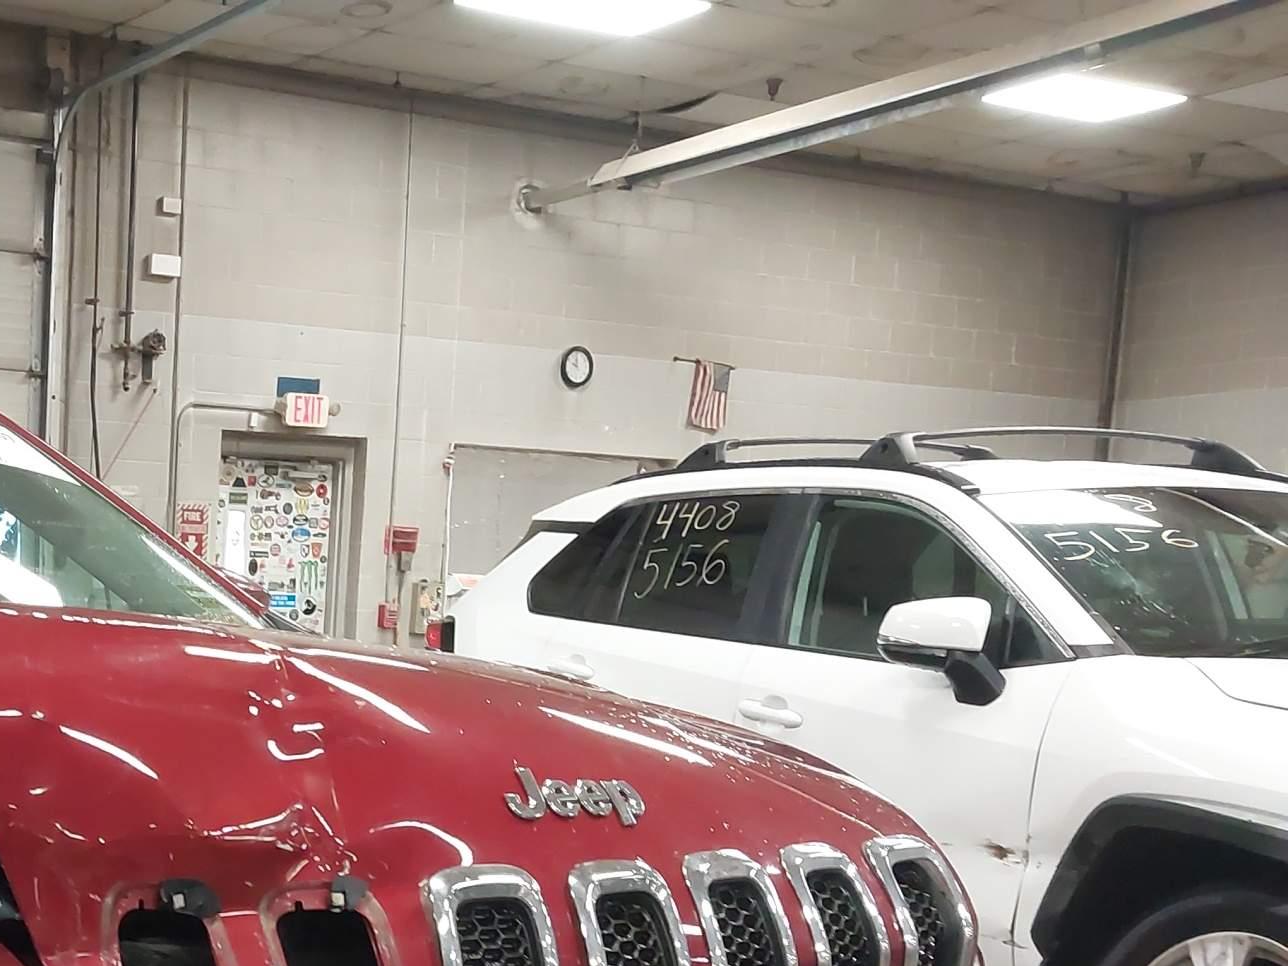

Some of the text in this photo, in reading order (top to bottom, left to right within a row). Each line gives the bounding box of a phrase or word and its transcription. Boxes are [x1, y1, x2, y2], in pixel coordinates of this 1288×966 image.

[294, 395, 324, 424] EXIT
[653, 500, 740, 543] 4408
[1044, 527, 1200, 561] 5156
[634, 539, 730, 599] 5156
[503, 766, 646, 826] Jeep
